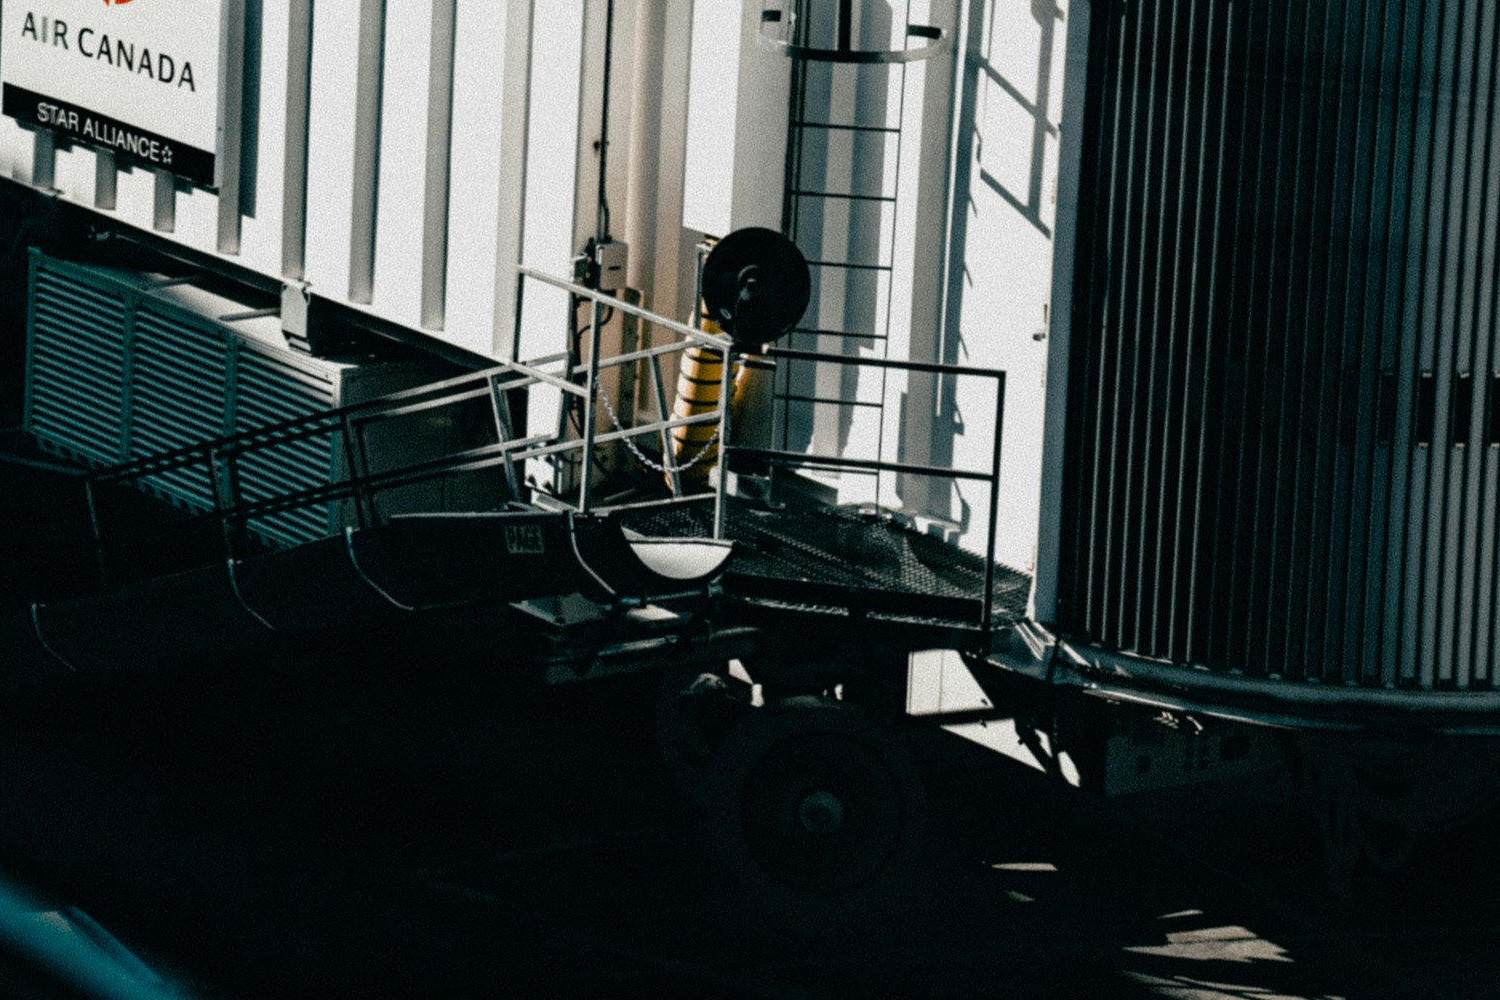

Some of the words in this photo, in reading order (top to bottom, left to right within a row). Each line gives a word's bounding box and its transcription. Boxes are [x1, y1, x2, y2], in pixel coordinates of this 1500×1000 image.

[22, 12, 69, 50] AIR
[78, 27, 196, 92] CANADA
[37, 102, 79, 132] STAR
[83, 118, 160, 162] ALLIANCE
